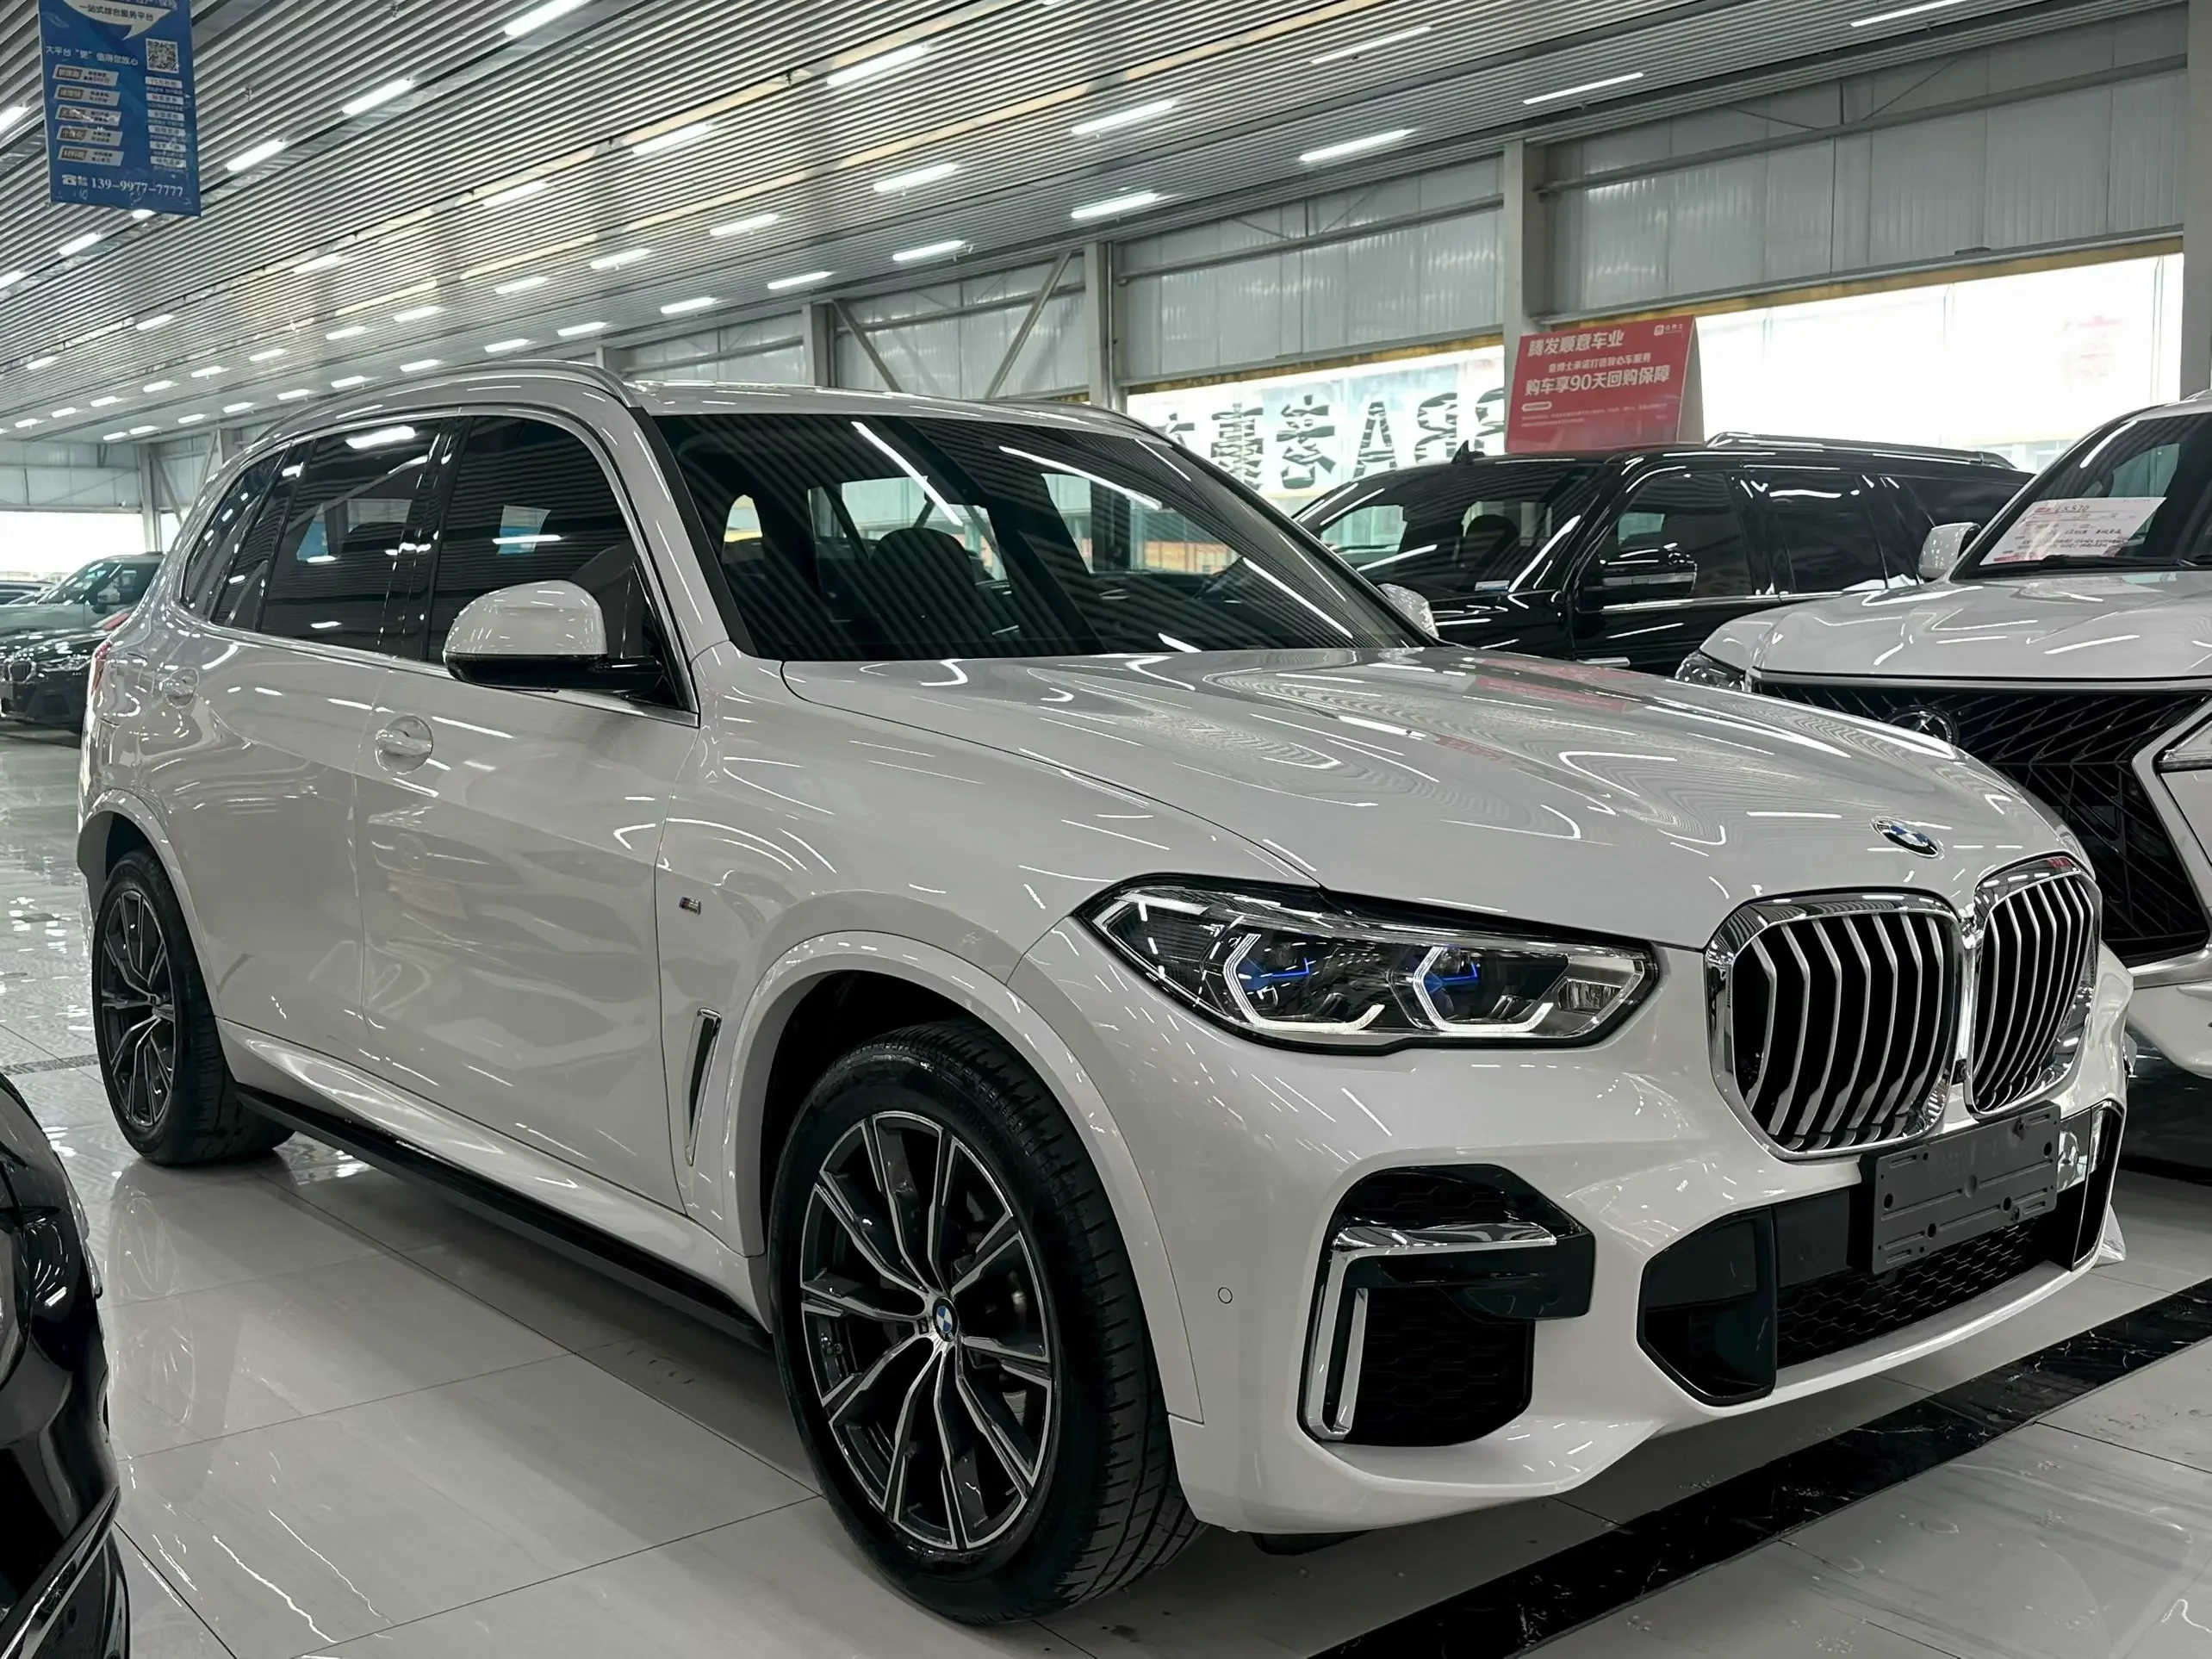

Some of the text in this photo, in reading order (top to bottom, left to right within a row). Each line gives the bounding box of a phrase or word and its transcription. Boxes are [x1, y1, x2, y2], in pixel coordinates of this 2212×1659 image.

[90, 177, 183, 196] 139-9977-7777
[1525, 364, 1670, 396] 购车享90天回购保障
